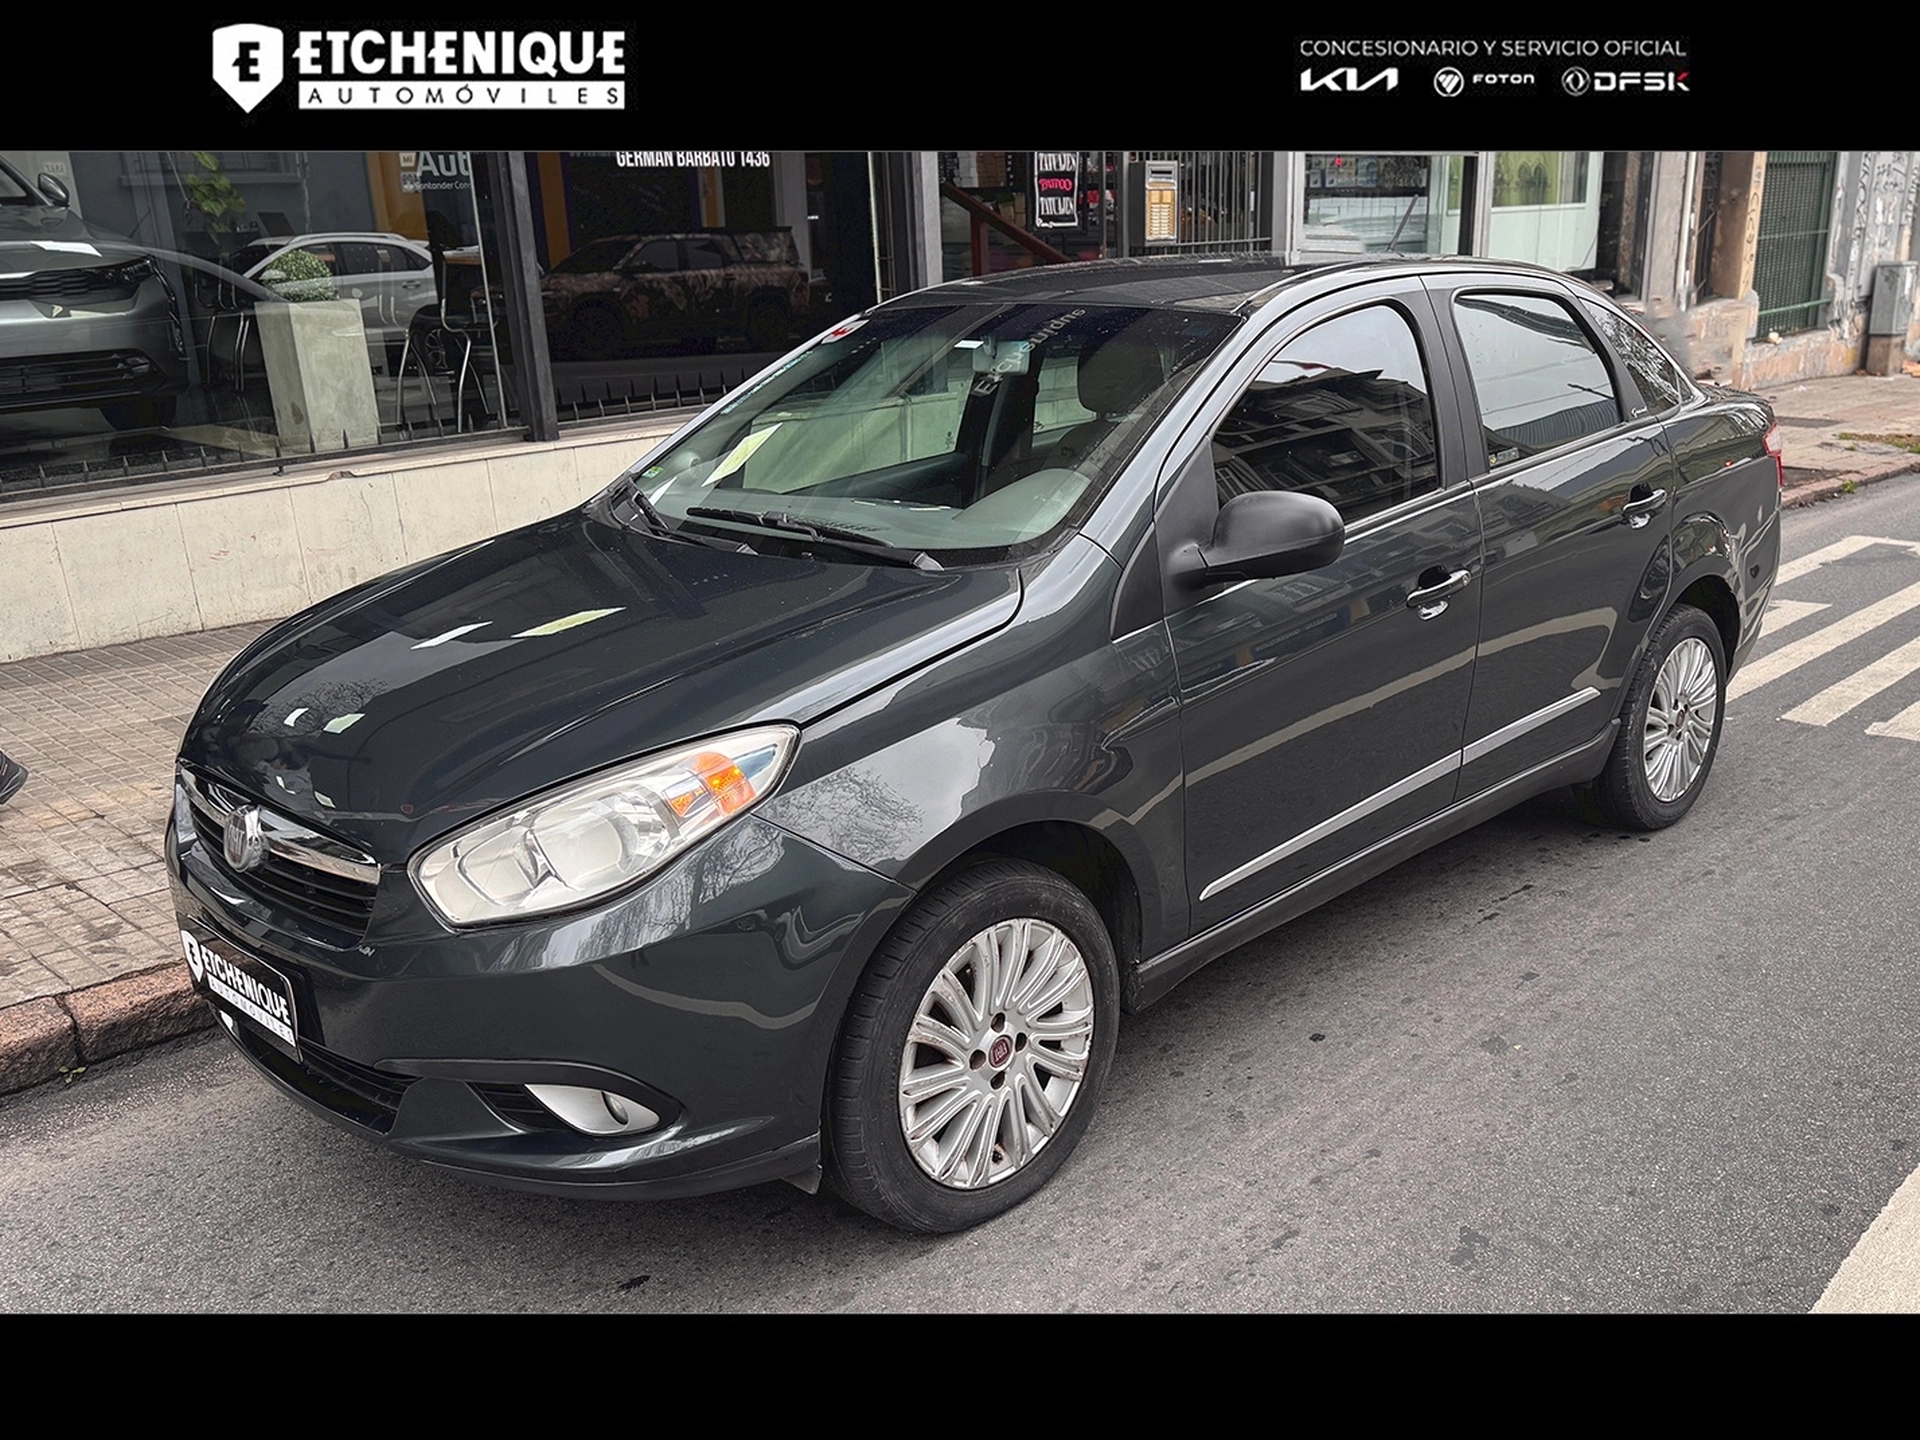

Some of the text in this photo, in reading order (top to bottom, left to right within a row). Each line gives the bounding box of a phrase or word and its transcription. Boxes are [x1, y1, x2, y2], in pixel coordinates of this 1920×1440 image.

[616, 151, 770, 167] GERMAN BARBATO 1436
[1039, 177, 1073, 191] TATTOO
[200, 944, 292, 1026] ETCHENIQUE
